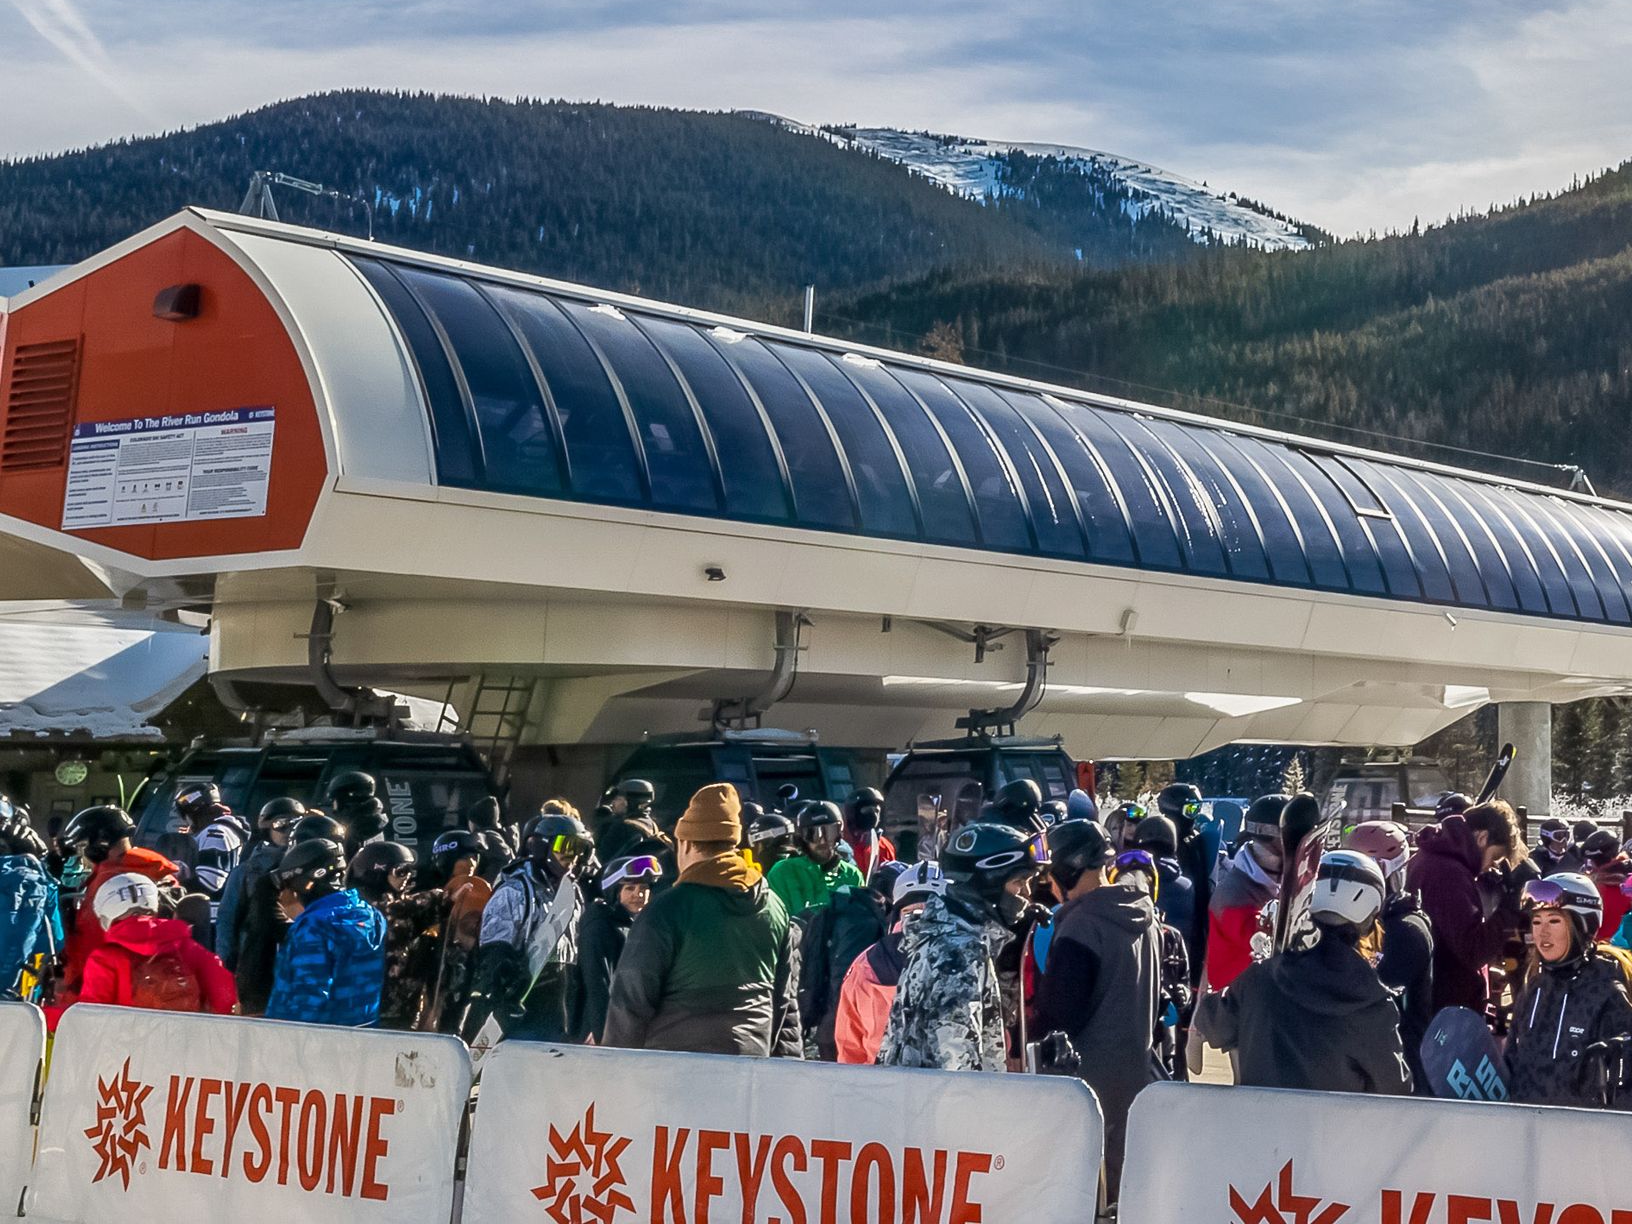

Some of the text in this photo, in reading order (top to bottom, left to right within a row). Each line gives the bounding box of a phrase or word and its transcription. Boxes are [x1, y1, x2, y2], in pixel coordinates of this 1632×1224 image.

[95, 410, 239, 433] Welcome To The River Run Gondola
[432, 841, 458, 855] GIRO
[158, 1075, 395, 1201] KEYSTONE
[651, 1125, 992, 1224] KEYSTONE
